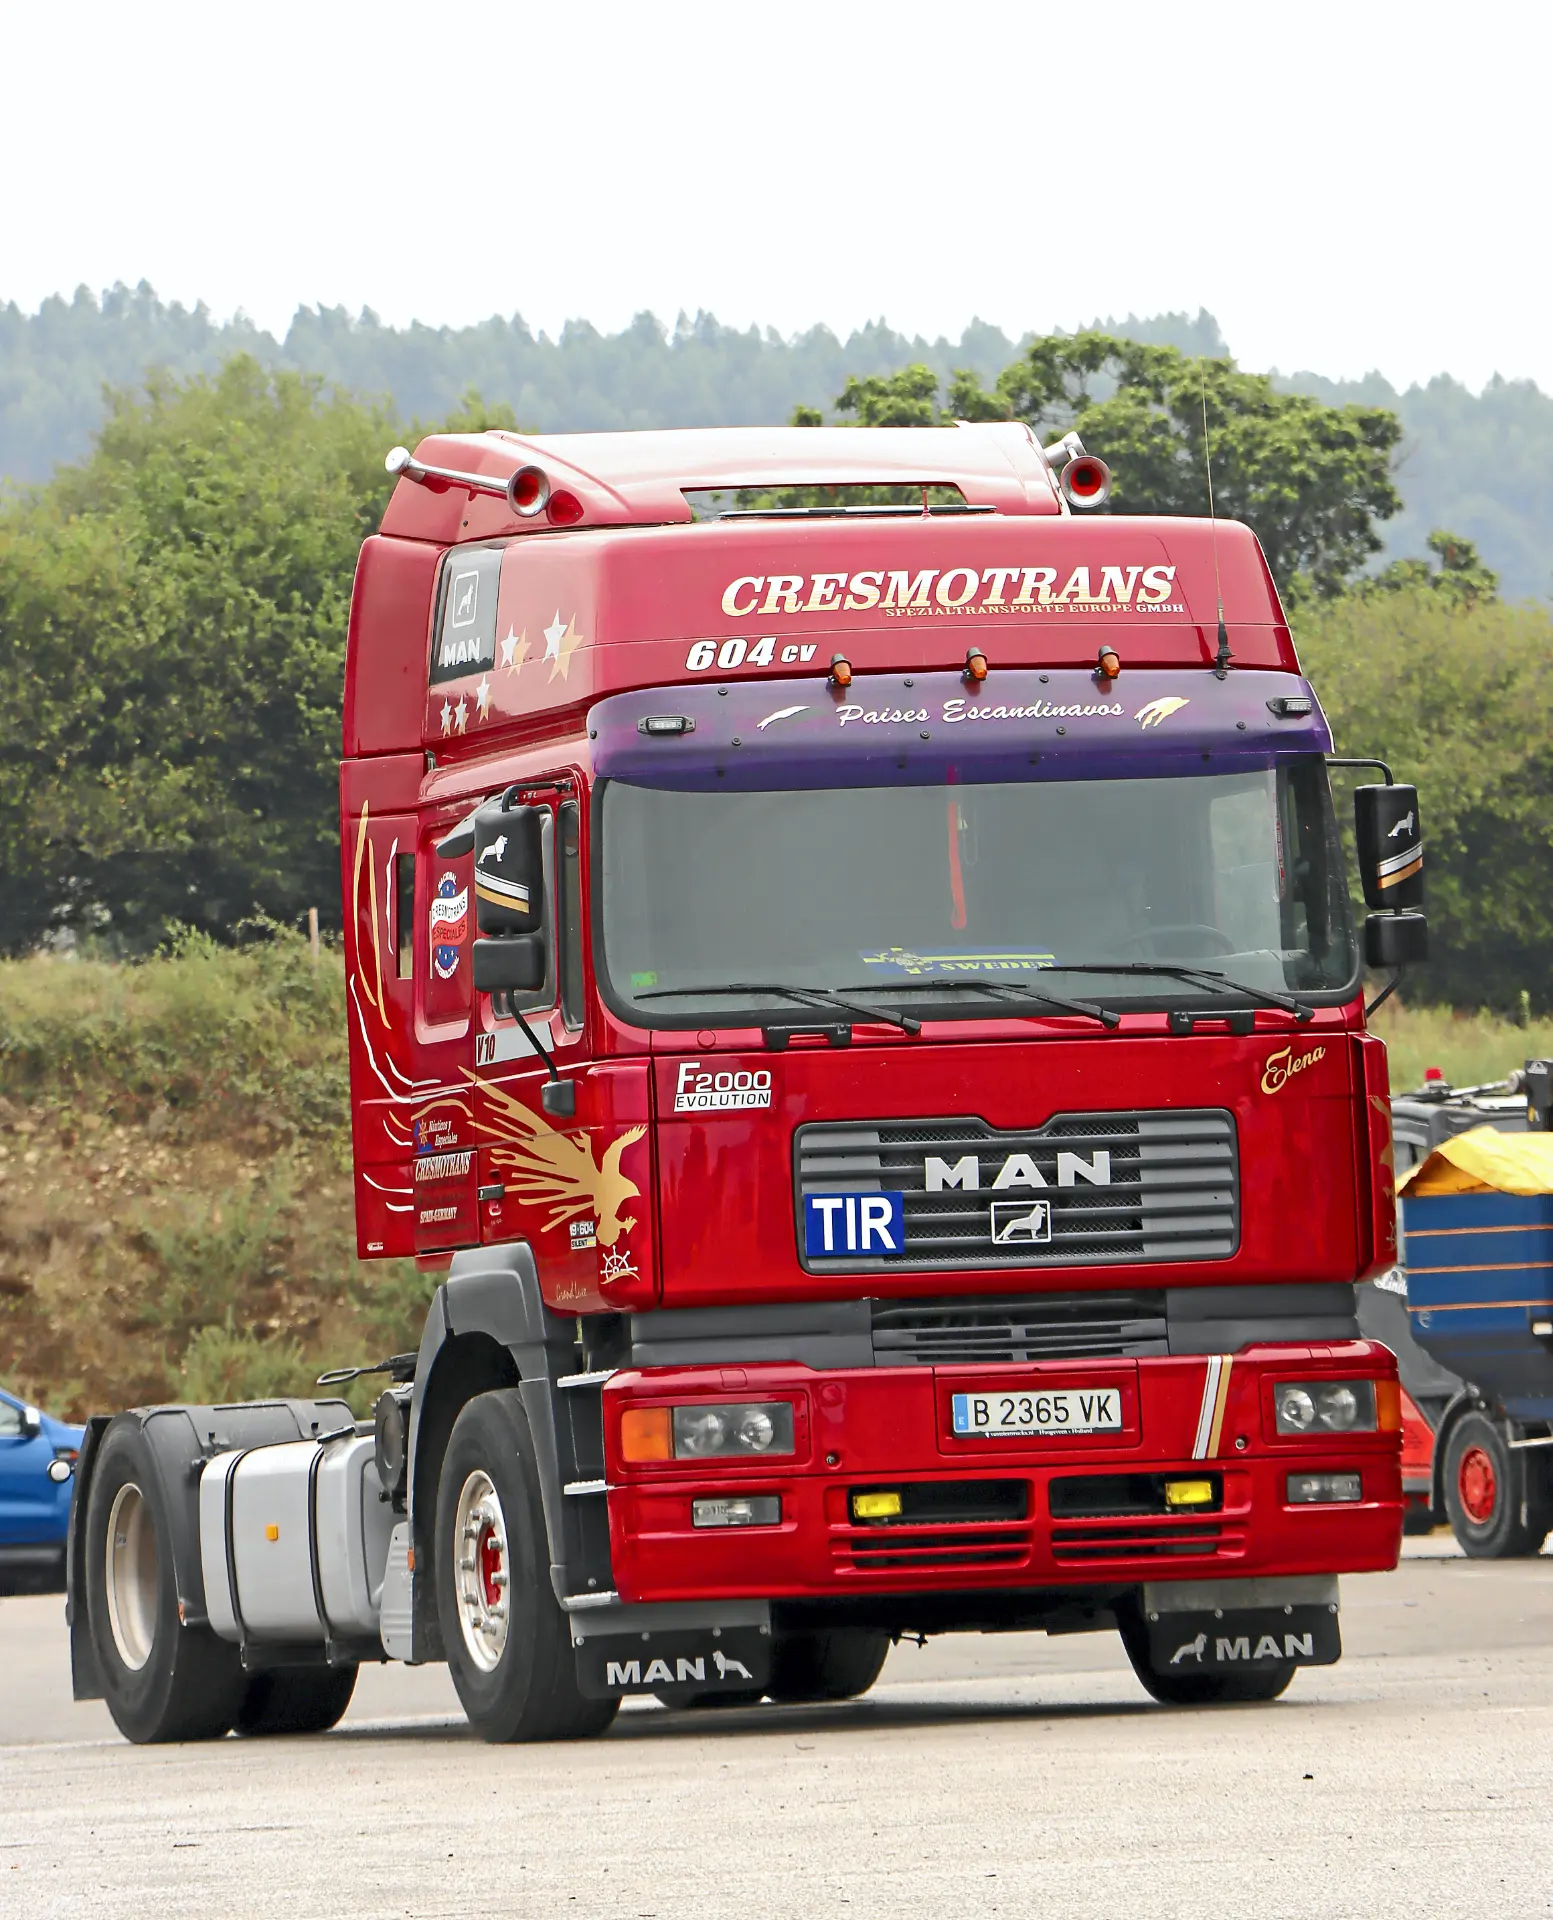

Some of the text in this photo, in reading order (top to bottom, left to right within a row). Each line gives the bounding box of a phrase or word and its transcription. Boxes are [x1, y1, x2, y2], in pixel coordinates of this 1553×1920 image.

[720, 565, 1176, 617] CRESMOTRANS
[885, 603, 1184, 617] SPEZIALTRANSPORTE EUROPE GMBH
[444, 637, 481, 668] MAN
[685, 636, 776, 672] 604
[835, 697, 1125, 728] Paises Escandinavos
[432, 920, 466, 941] ESPECIALES
[940, 961, 1055, 971] SWEDEN
[677, 1062, 772, 1094] F2000
[1260, 1045, 1326, 1095] Elena
[675, 1092, 770, 1109] EVOLUTION
[415, 1152, 472, 1182] CRESMOTRANS
[924, 1150, 1111, 1192] MAN
[811, 1196, 897, 1252] TIR
[571, 1238, 588, 1248] SILENT
[958, 1416, 965, 1426] E
[973, 1394, 1114, 1427] B 2365 VK
[1215, 1632, 1314, 1662] MAN
[606, 1657, 706, 1686] MAN
